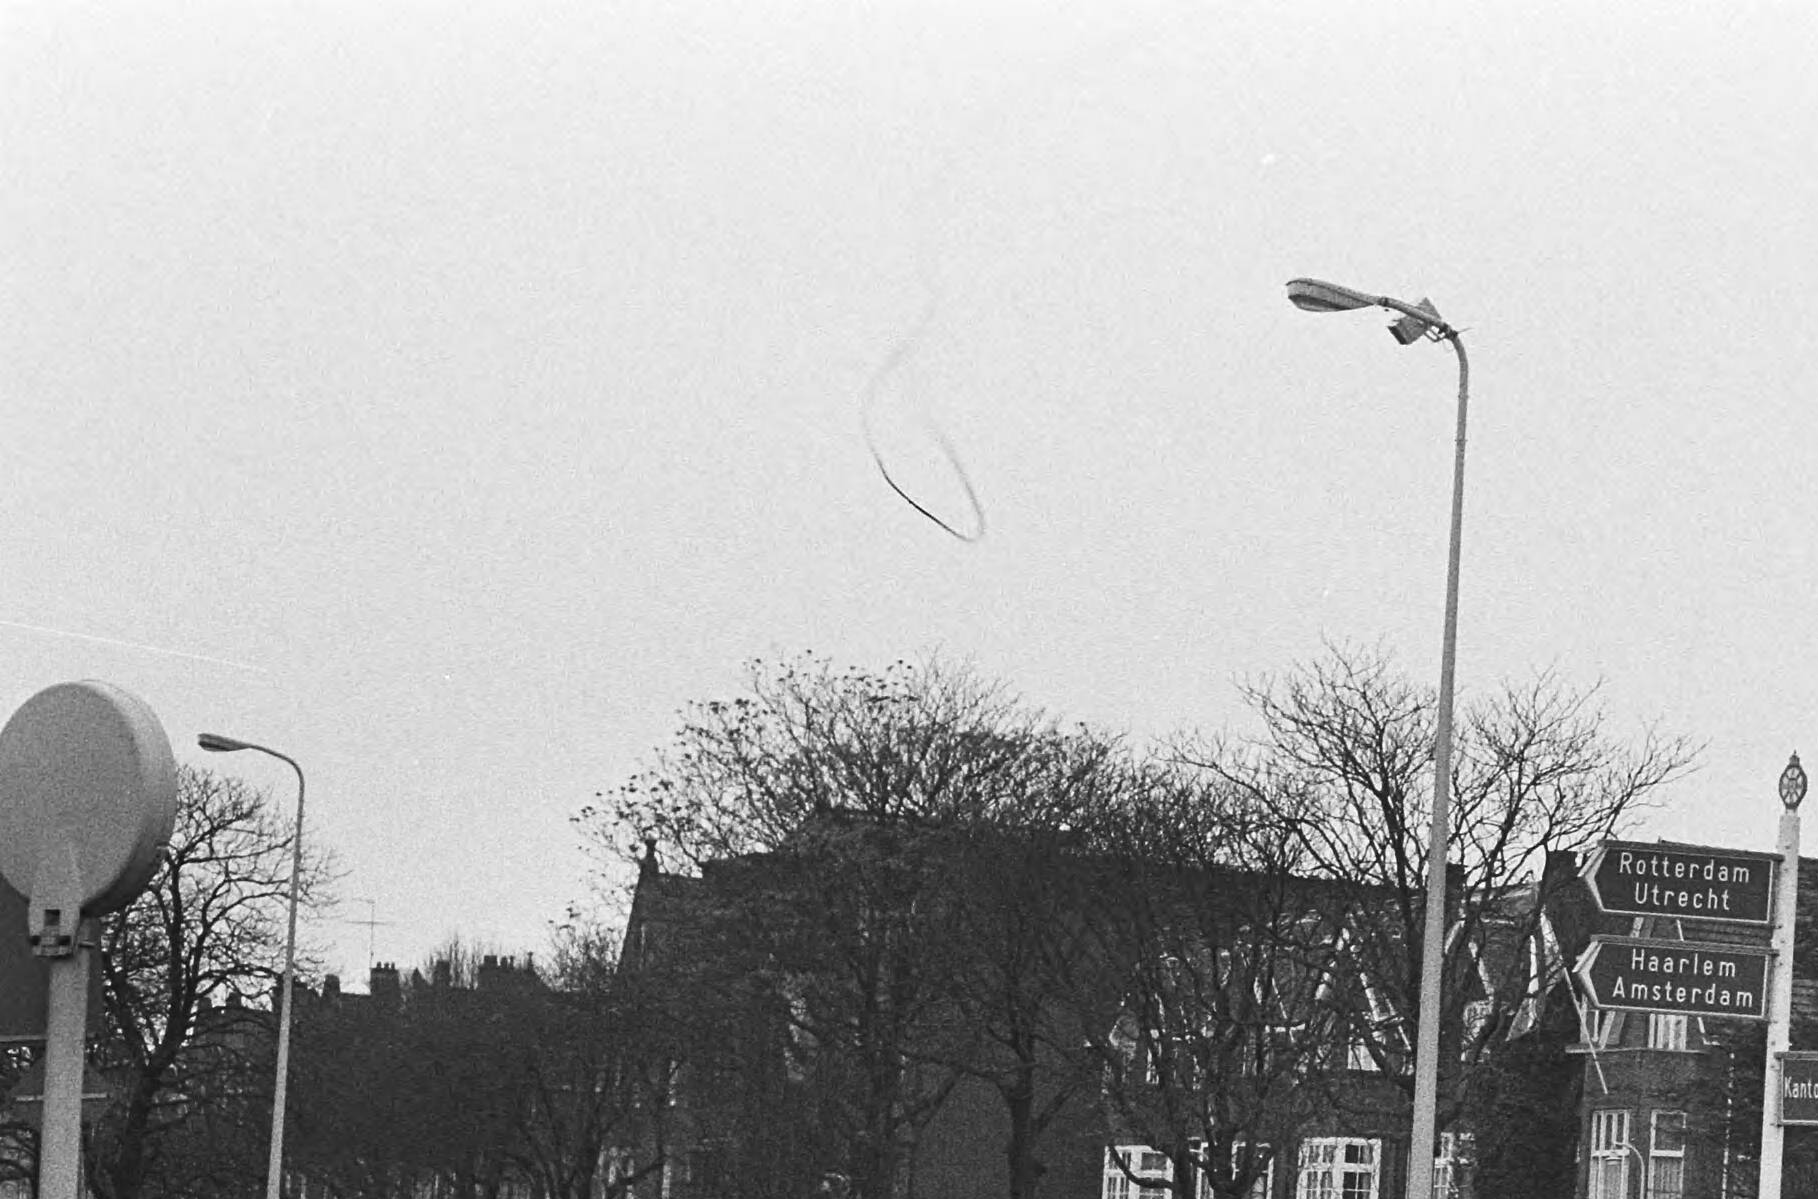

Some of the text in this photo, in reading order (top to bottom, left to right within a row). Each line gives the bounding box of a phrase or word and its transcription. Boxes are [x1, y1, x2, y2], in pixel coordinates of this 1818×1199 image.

[1619, 852, 1749, 883] Rotterdam
[1635, 882, 1730, 911] Utrecht
[1631, 948, 1736, 978] Haarlem
[1612, 976, 1753, 1008] Amsterdam
